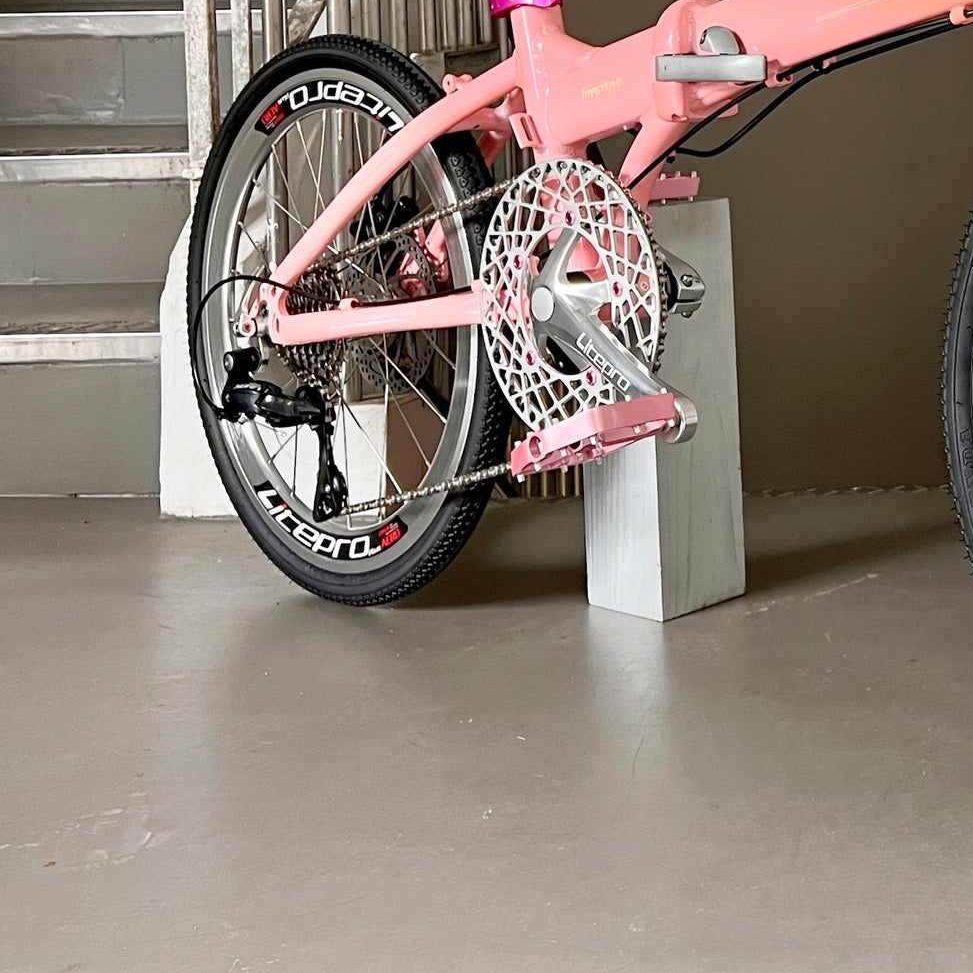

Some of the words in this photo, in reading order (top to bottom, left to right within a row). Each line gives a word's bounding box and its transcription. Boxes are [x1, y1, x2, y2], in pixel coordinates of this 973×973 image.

[289, 81, 405, 132] Litepro
[576, 332, 630, 392] Litepro
[257, 489, 370, 559] Litepro
